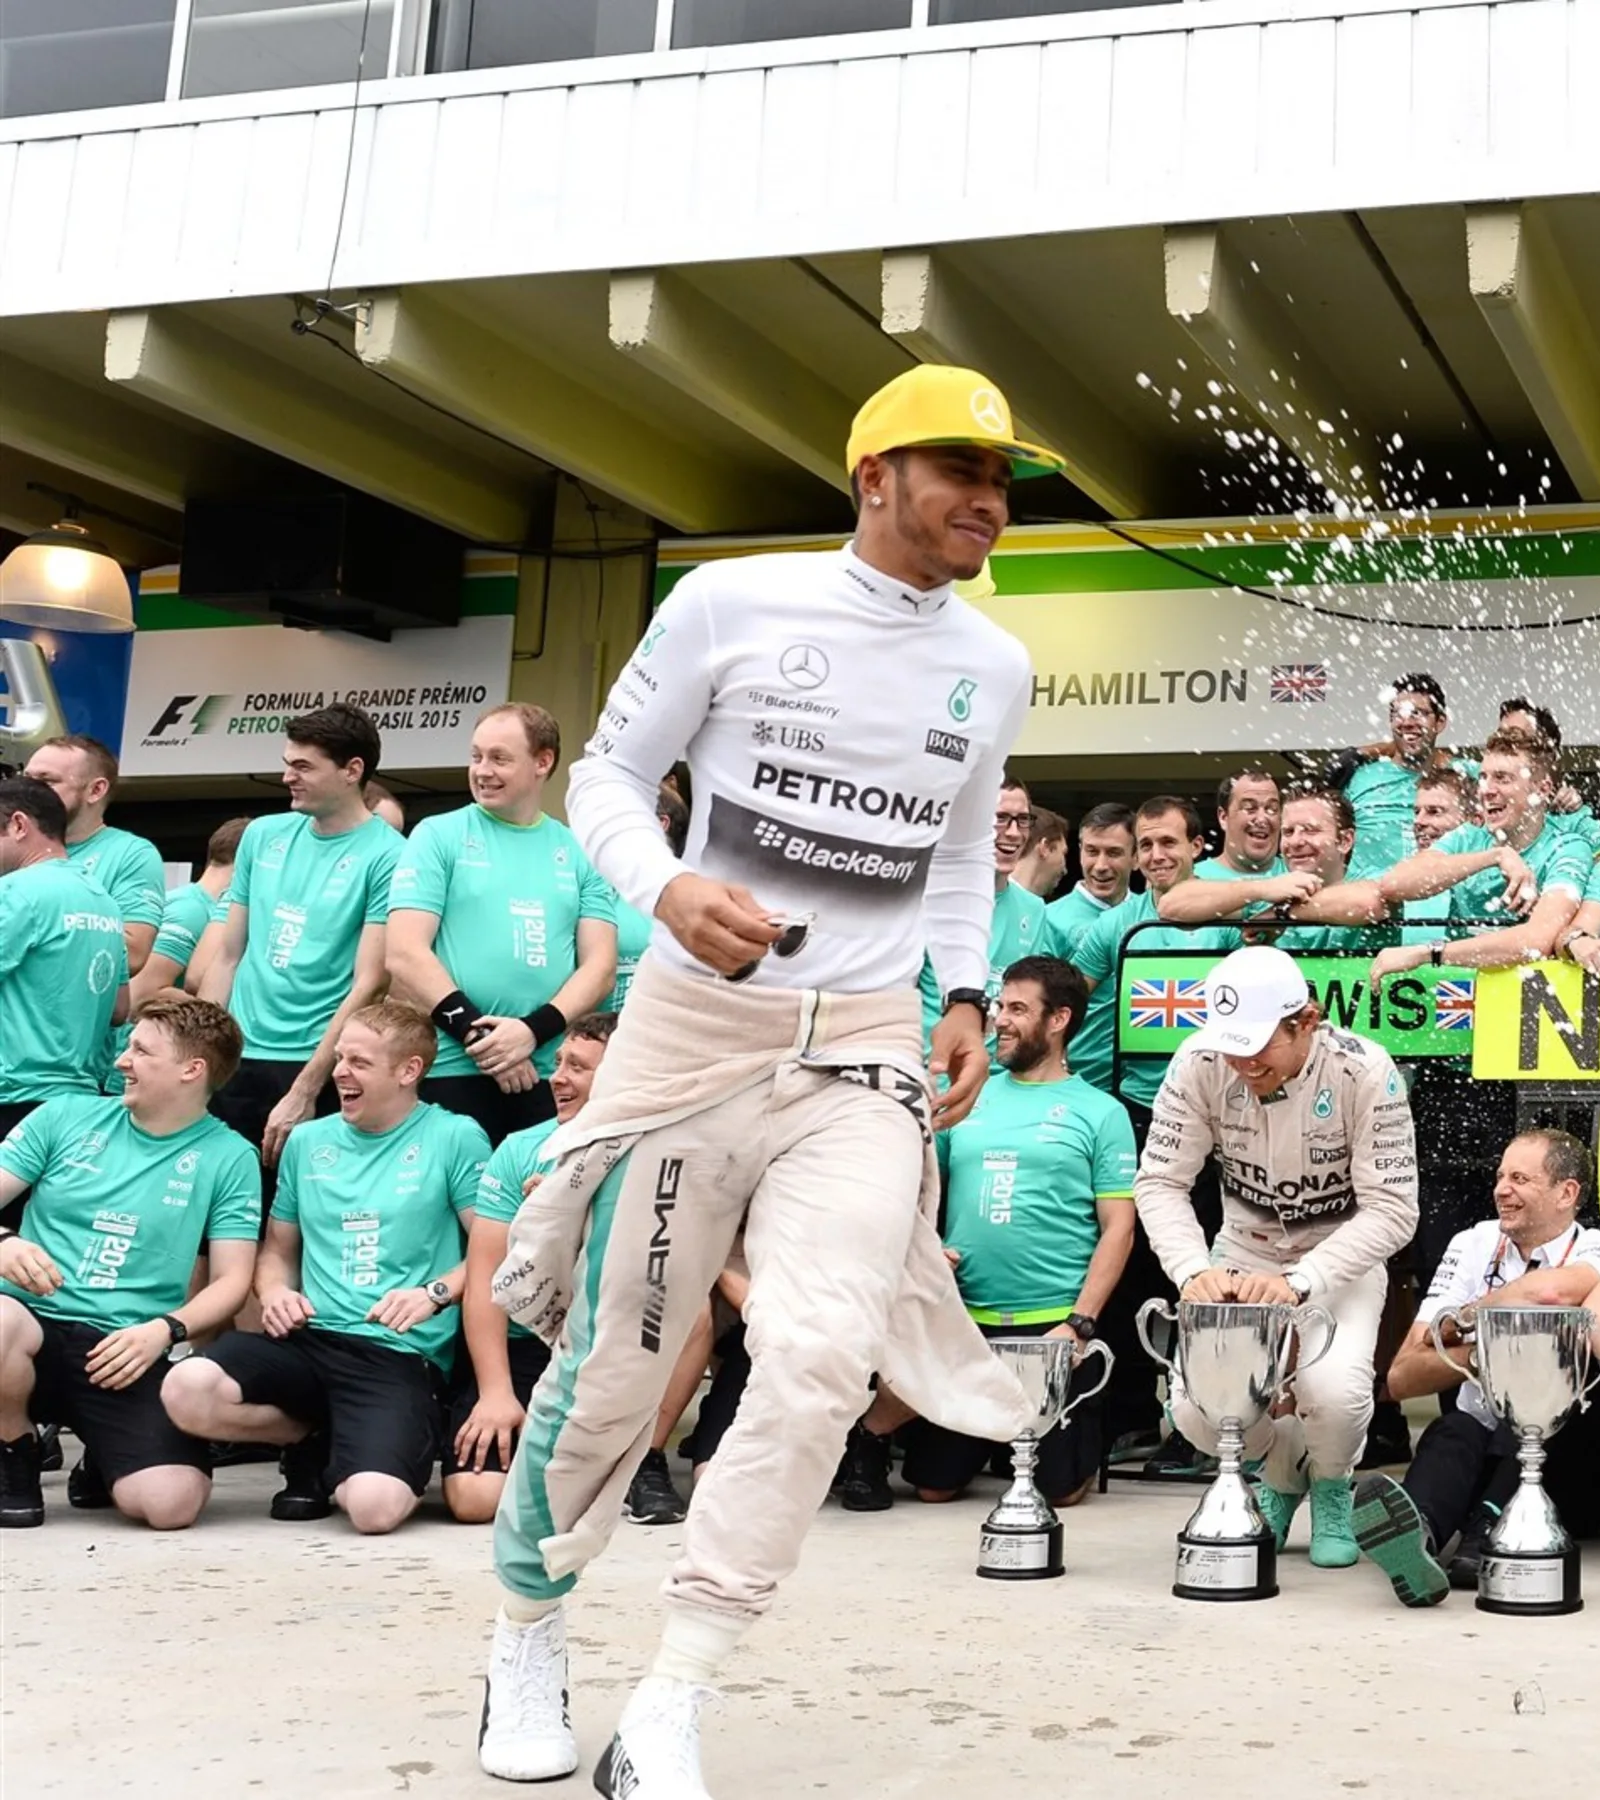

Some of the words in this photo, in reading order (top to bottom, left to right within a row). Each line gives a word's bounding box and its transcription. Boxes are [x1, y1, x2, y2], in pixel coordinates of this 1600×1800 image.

[243, 692, 325, 712] FORMULA
[349, 686, 416, 708] GRANDE
[419, 681, 487, 704] PRÊMIO
[765, 694, 840, 719] BlackBerry
[1030, 669, 1248, 707] HAMILTON
[227, 715, 295, 735] PETROB
[366, 708, 414, 730] RASIL
[419, 711, 460, 729] 2015
[780, 726, 826, 752] UBS
[928, 731, 967, 756] BOSS
[752, 761, 949, 827] PETRONAS
[783, 836, 918, 884] BlackBerry
[525, 918, 547, 968] 2015
[1305, 978, 1428, 1030] WIS
[989, 1172, 1016, 1225] 2015
[95, 1211, 139, 1225] RACE
[353, 1231, 379, 1288] 2015
